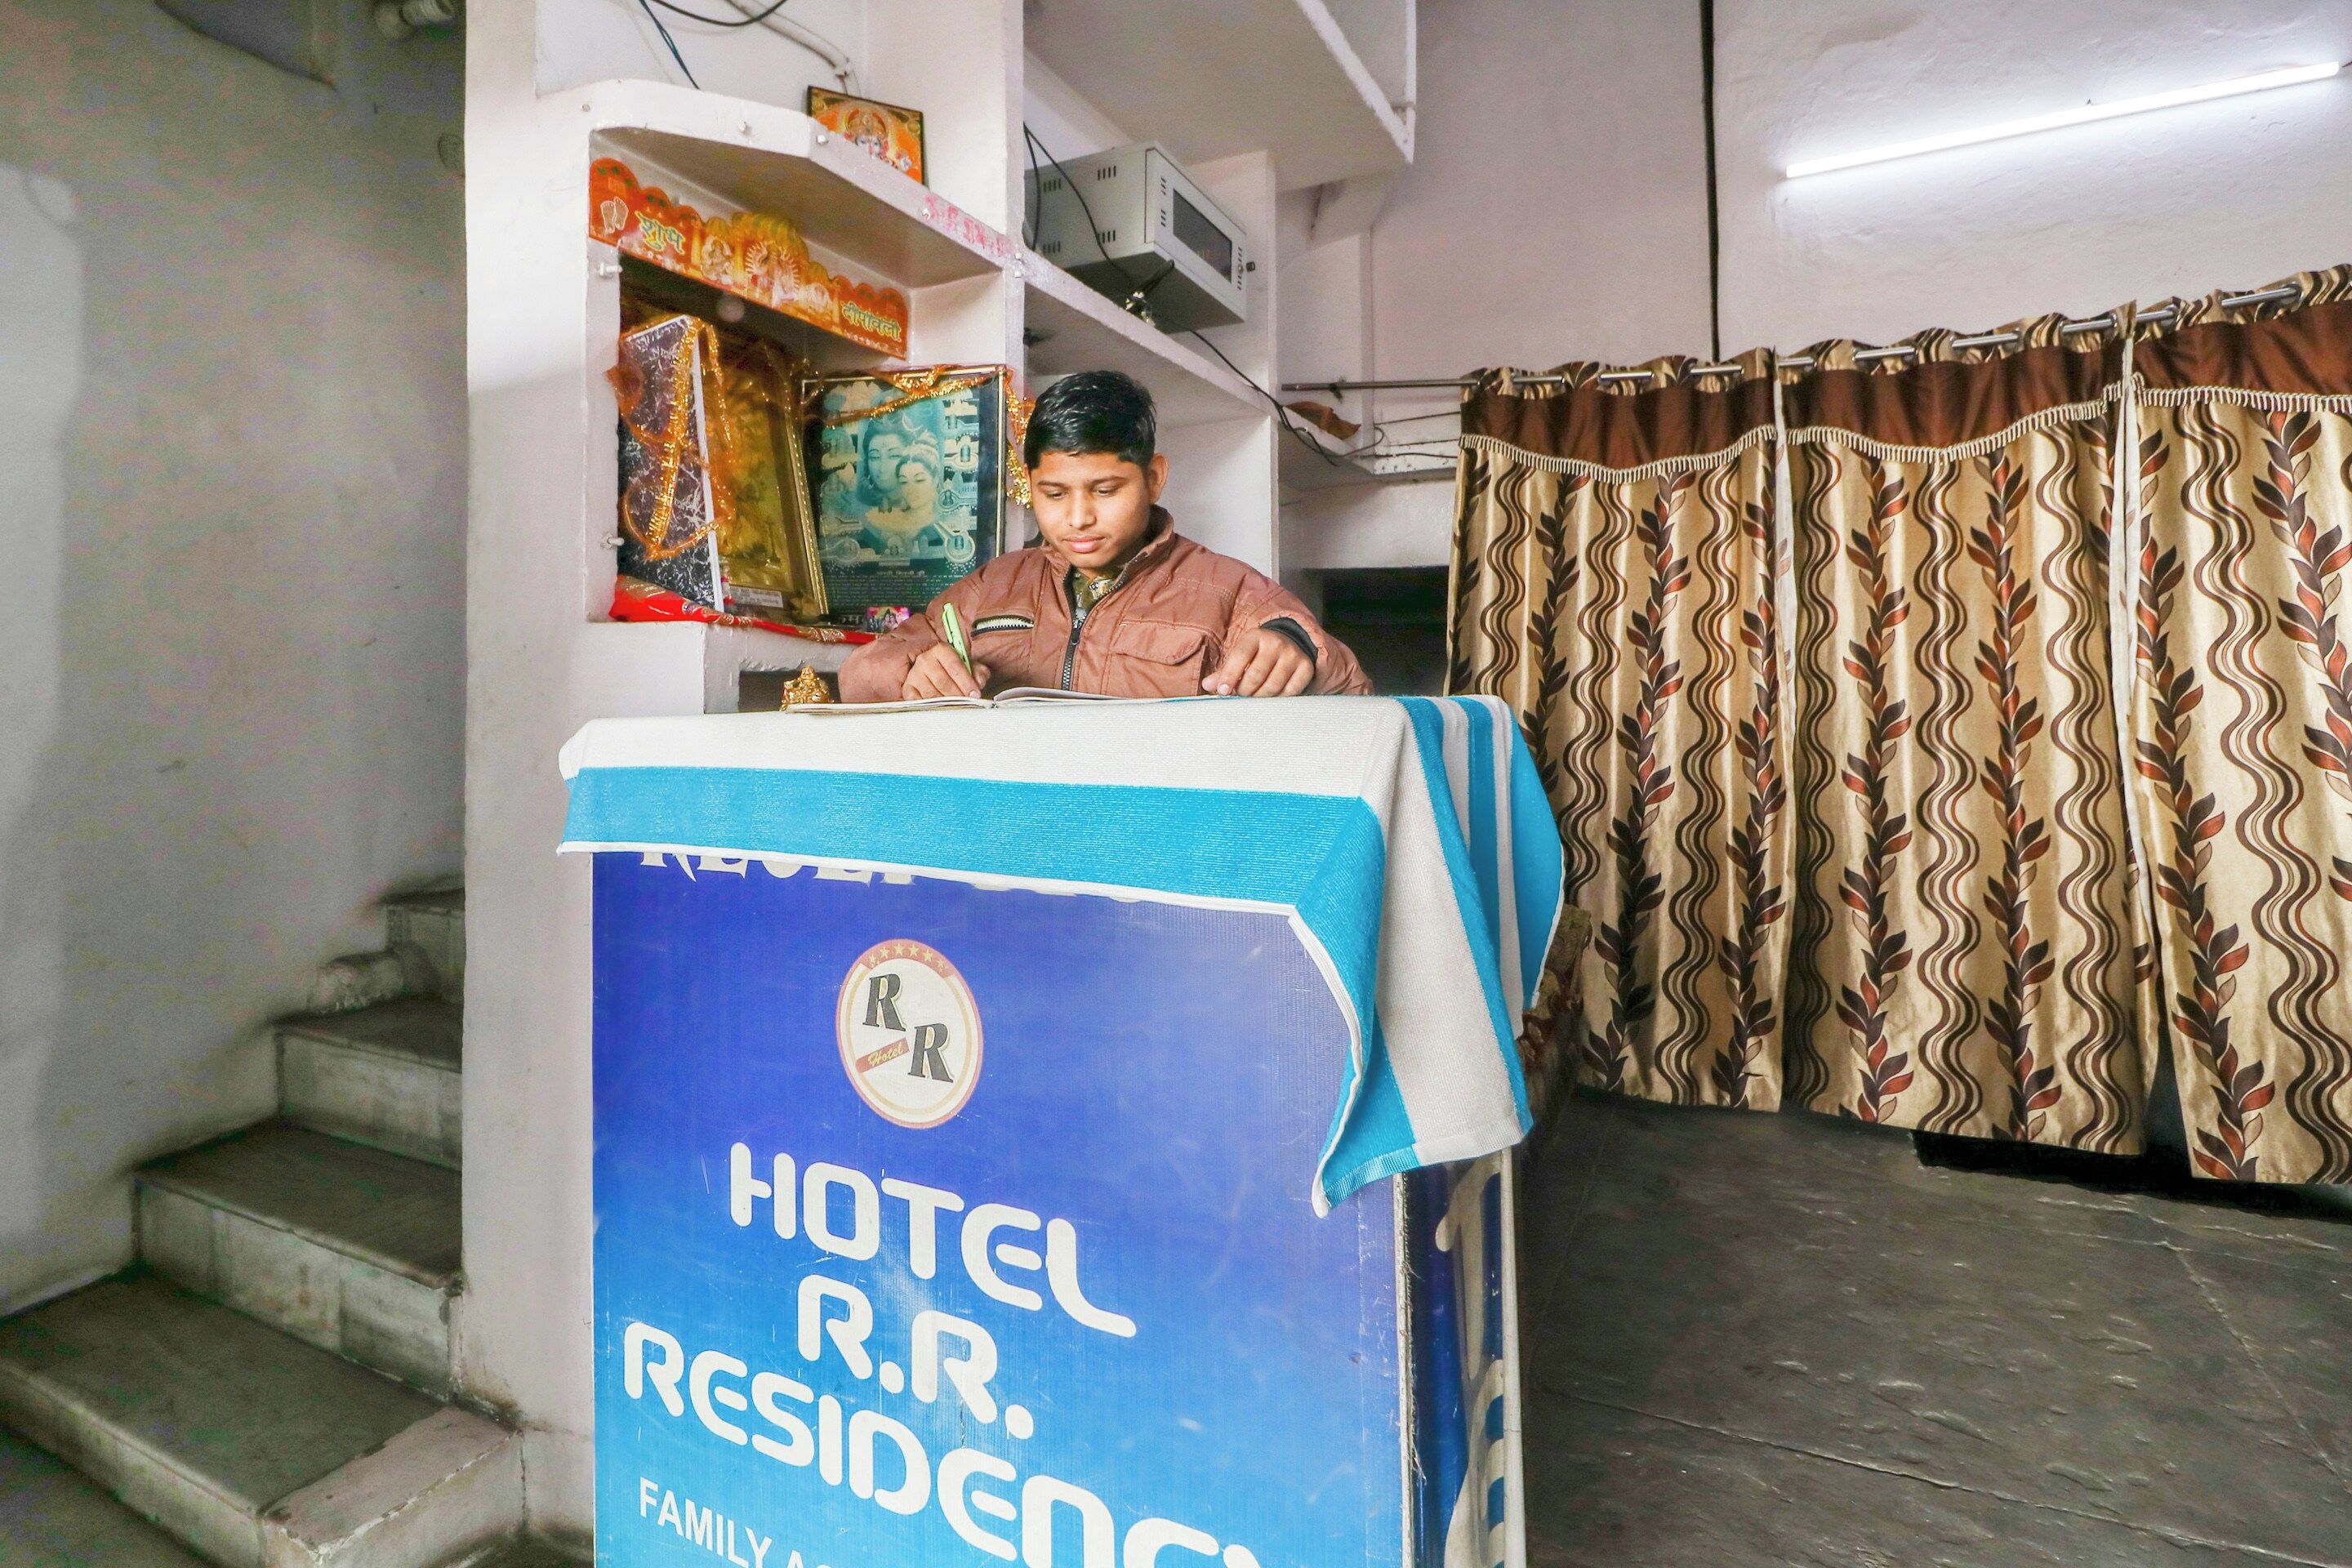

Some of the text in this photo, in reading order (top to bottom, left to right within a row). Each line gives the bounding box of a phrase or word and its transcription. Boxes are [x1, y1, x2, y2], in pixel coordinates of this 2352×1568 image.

[635, 211, 902, 342] शुभ दीपावली
[862, 973, 906, 1032] R
[867, 1041, 905, 1067] Hotel
[907, 1022, 955, 1083] R
[730, 1142, 1137, 1338] HOTEL
[797, 1273, 1035, 1440] R.R.
[623, 1321, 1261, 1568] RESIDEN
[639, 1476, 773, 1568] FAMILY
